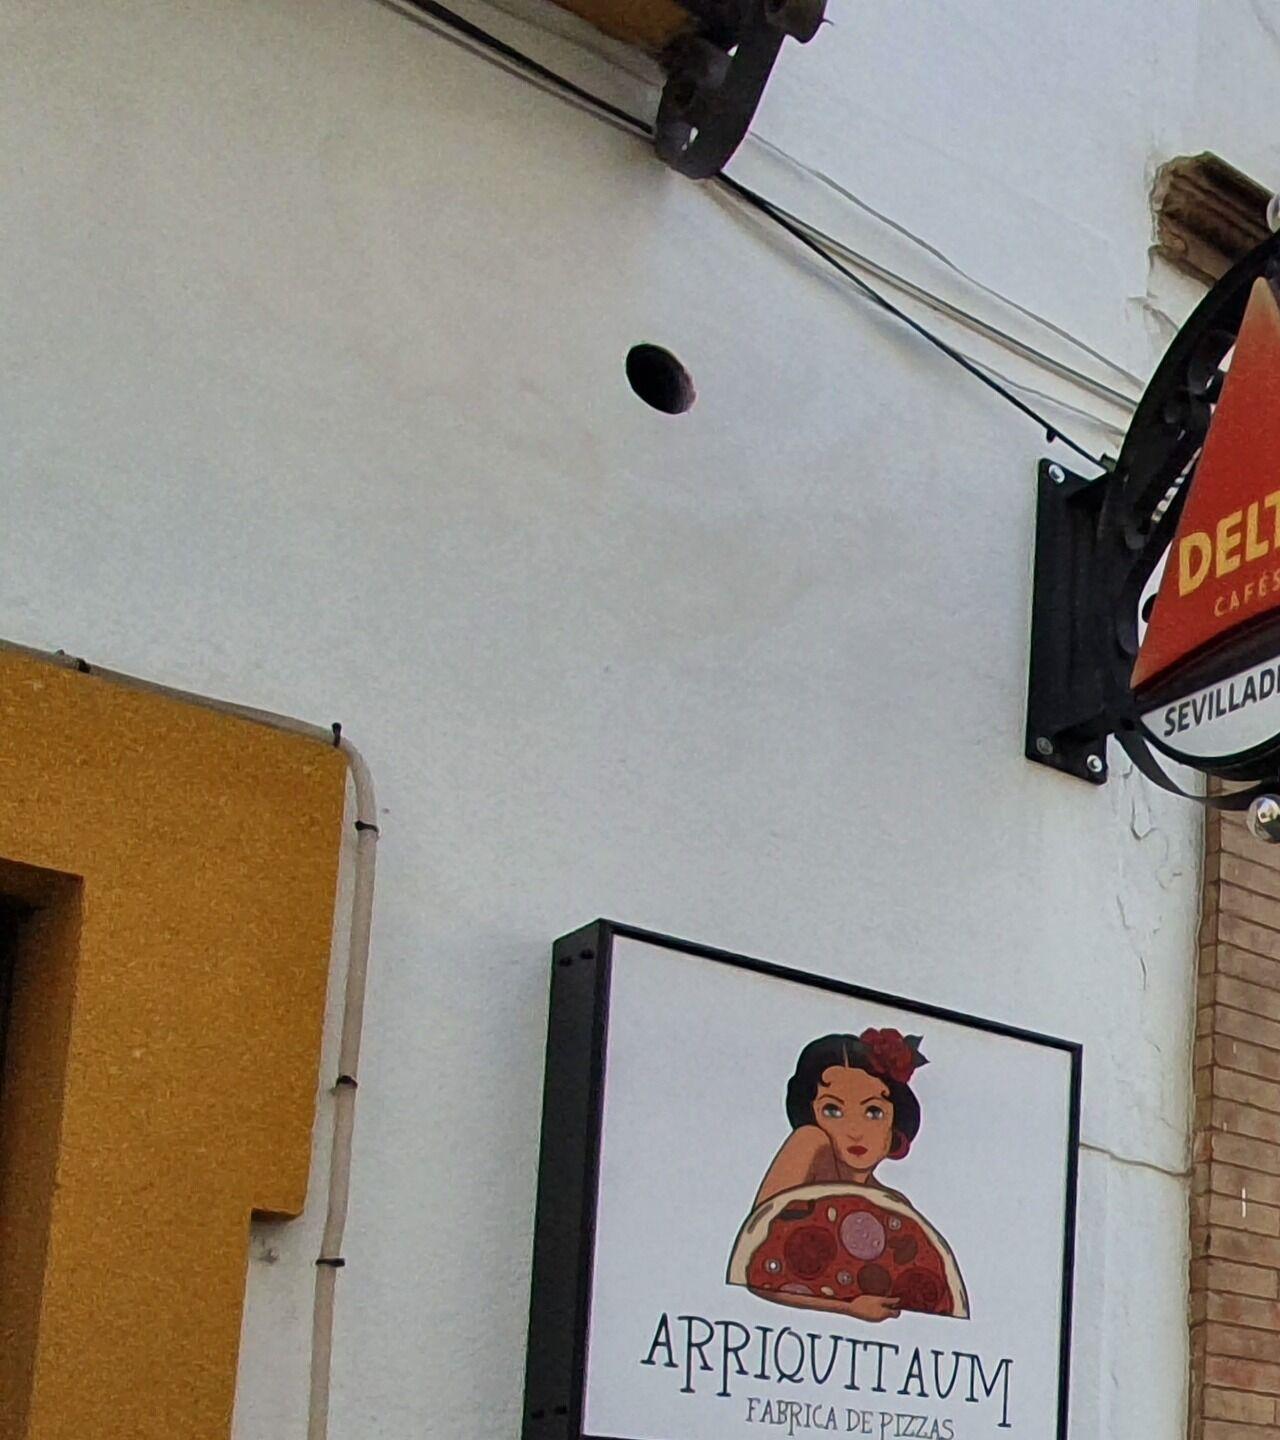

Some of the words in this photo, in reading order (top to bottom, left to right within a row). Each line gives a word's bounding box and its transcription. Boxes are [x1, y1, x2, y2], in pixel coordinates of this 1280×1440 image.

[640, 1312, 1014, 1428] ARRIQUITAUM
[745, 1396, 838, 1436] FABRICA
[846, 1410, 873, 1434] DE
